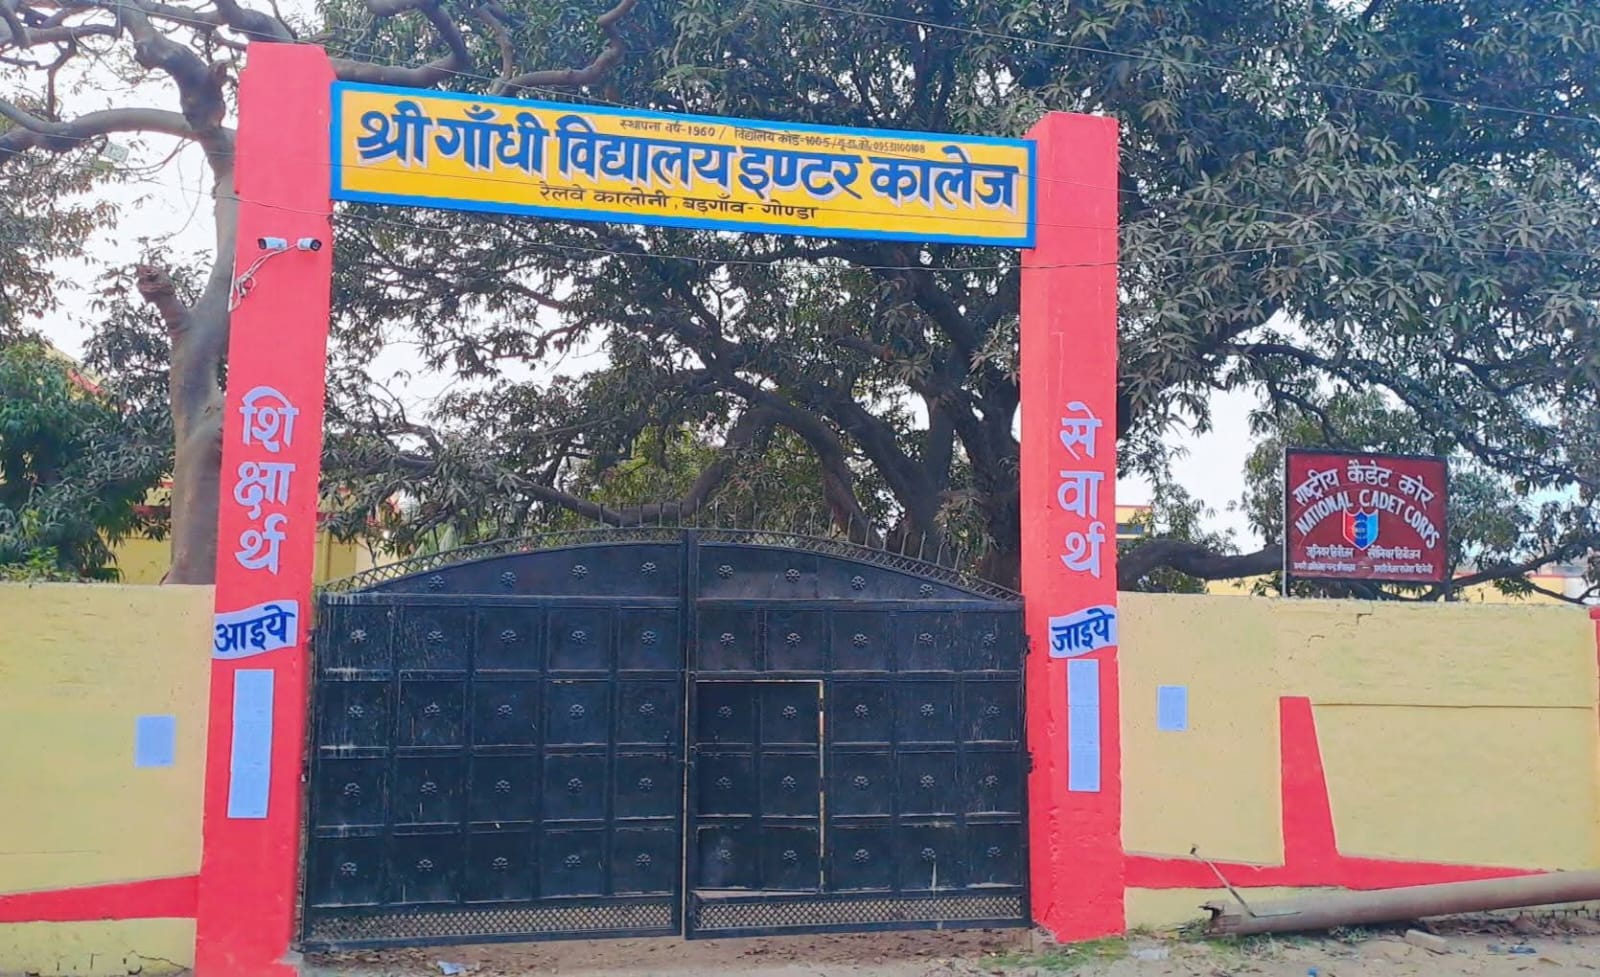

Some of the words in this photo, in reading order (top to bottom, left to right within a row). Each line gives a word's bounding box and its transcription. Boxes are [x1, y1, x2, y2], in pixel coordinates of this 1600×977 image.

[619, 118, 662, 133] स्थापना
[356, 99, 434, 166] श्री
[434, 103, 550, 176] गाँधी
[554, 114, 738, 191] विद्यालय
[738, 144, 864, 201] इण्टर
[868, 145, 1020, 212] कालेज
[539, 181, 586, 202] रेलवे
[761, 199, 819, 220] गोण्डा
[1292, 468, 1341, 507] राष्ट्रीय
[1346, 458, 1393, 488] कैडेट
[1397, 474, 1436, 511] कोर
[1294, 490, 1354, 537] NATIONAL
[1358, 488, 1406, 517] CADET
[1403, 504, 1441, 550] CORPS
[214, 604, 296, 653] आइये
[1051, 607, 1115, 652] जाइये
